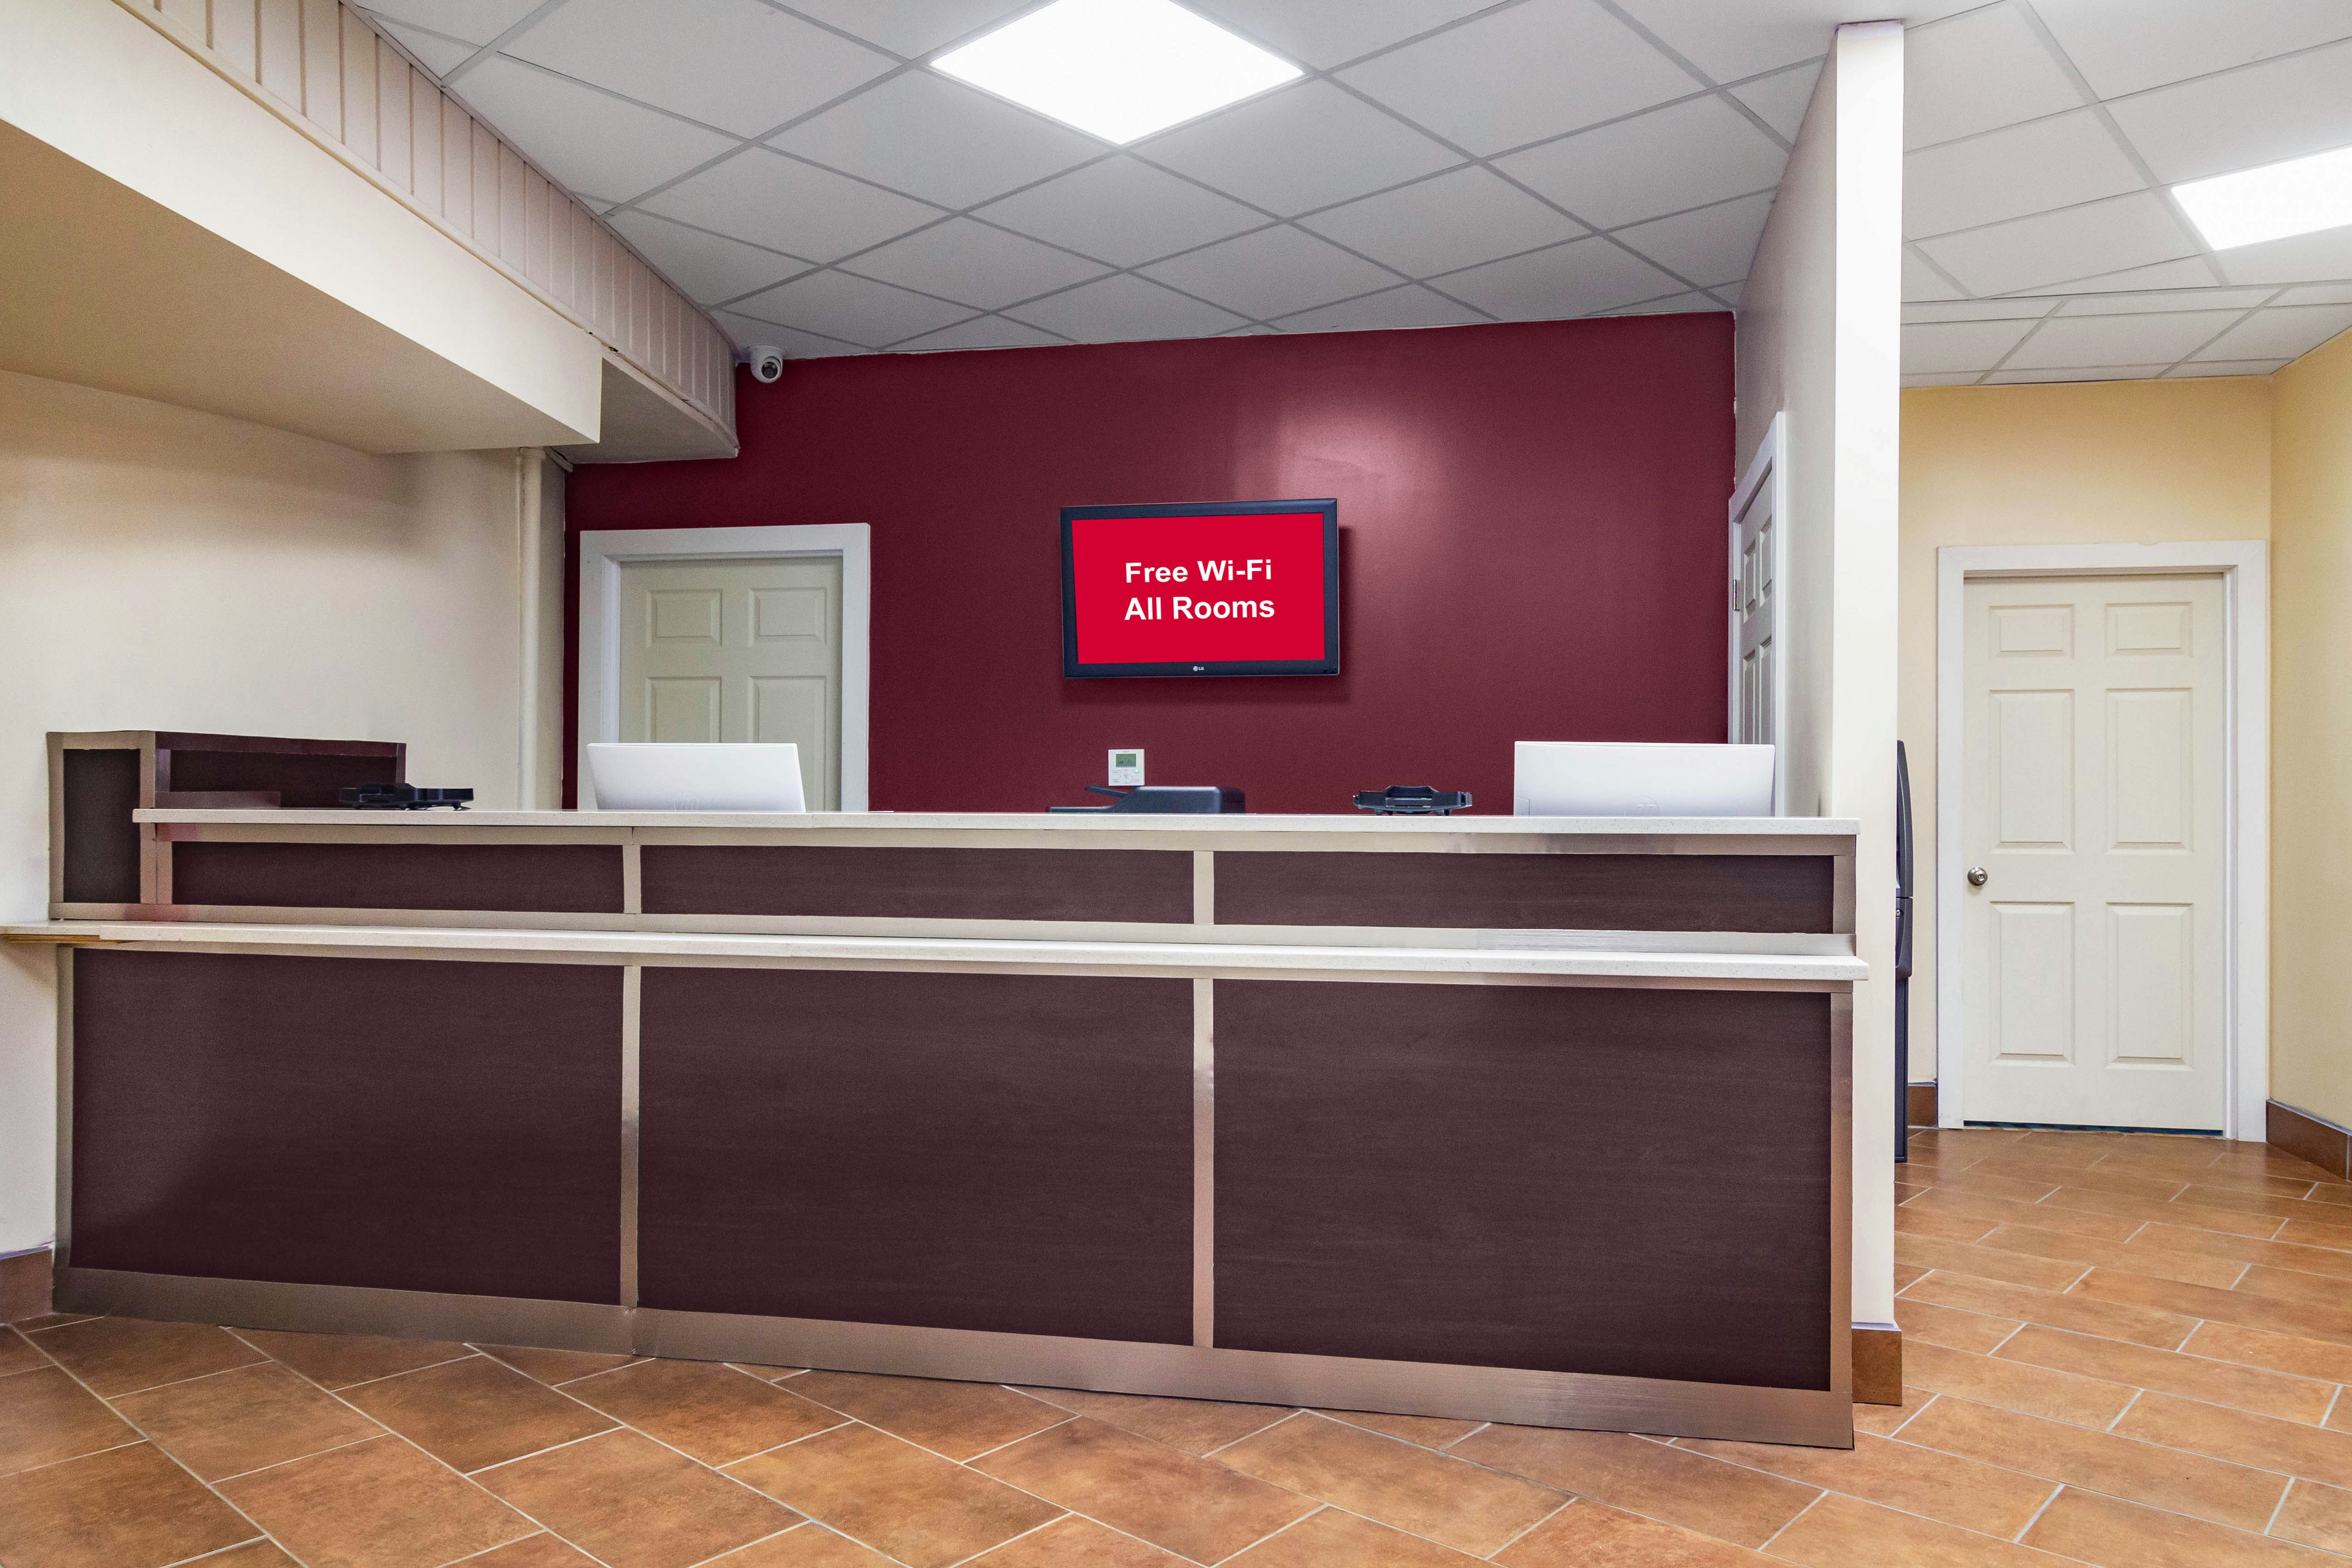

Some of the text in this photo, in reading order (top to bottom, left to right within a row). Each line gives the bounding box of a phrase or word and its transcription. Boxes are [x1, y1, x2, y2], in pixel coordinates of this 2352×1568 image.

[1126, 559, 1271, 583] Free Wi-Fi
[1124, 596, 1275, 620] All Rooms
